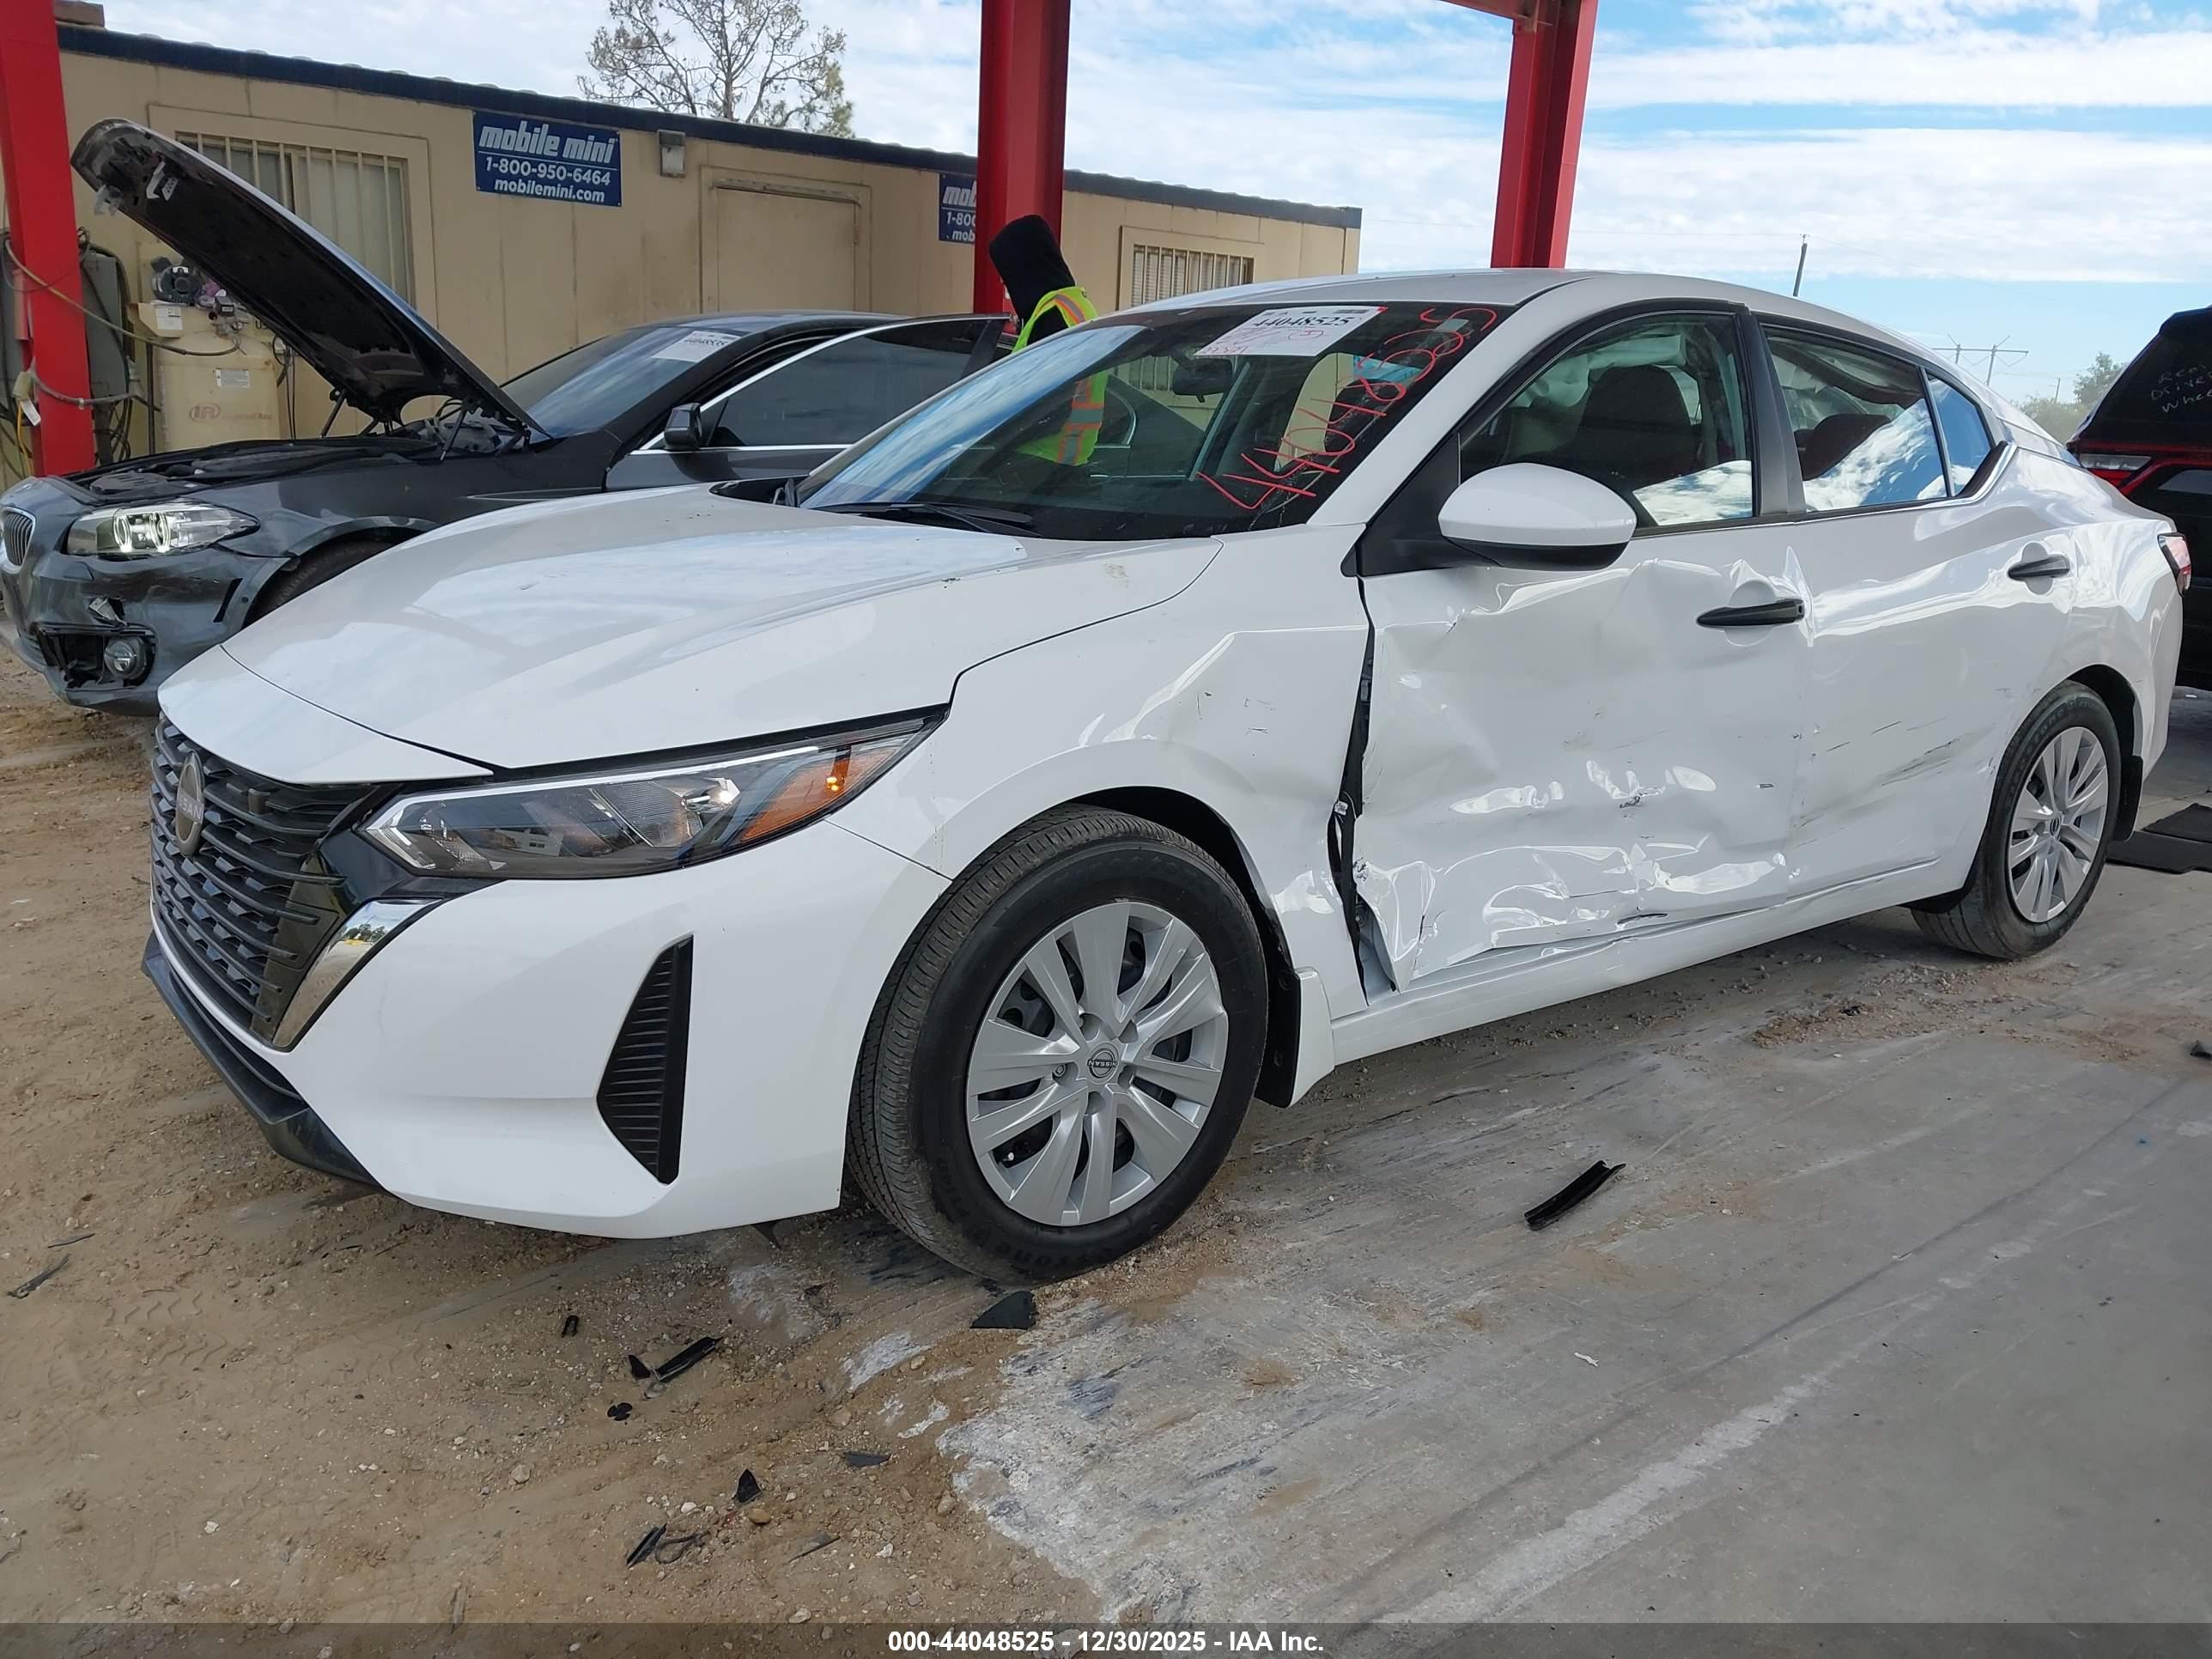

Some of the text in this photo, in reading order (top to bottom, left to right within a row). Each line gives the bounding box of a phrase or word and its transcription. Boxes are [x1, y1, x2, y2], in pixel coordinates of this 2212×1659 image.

[478, 120, 616, 163] mobile mini
[485, 156, 611, 186] 1-800-950-6464
[494, 178, 605, 203] mobilemini.com
[1253, 316, 1353, 327] 44048525
[1196, 307, 1498, 509] 44048525
